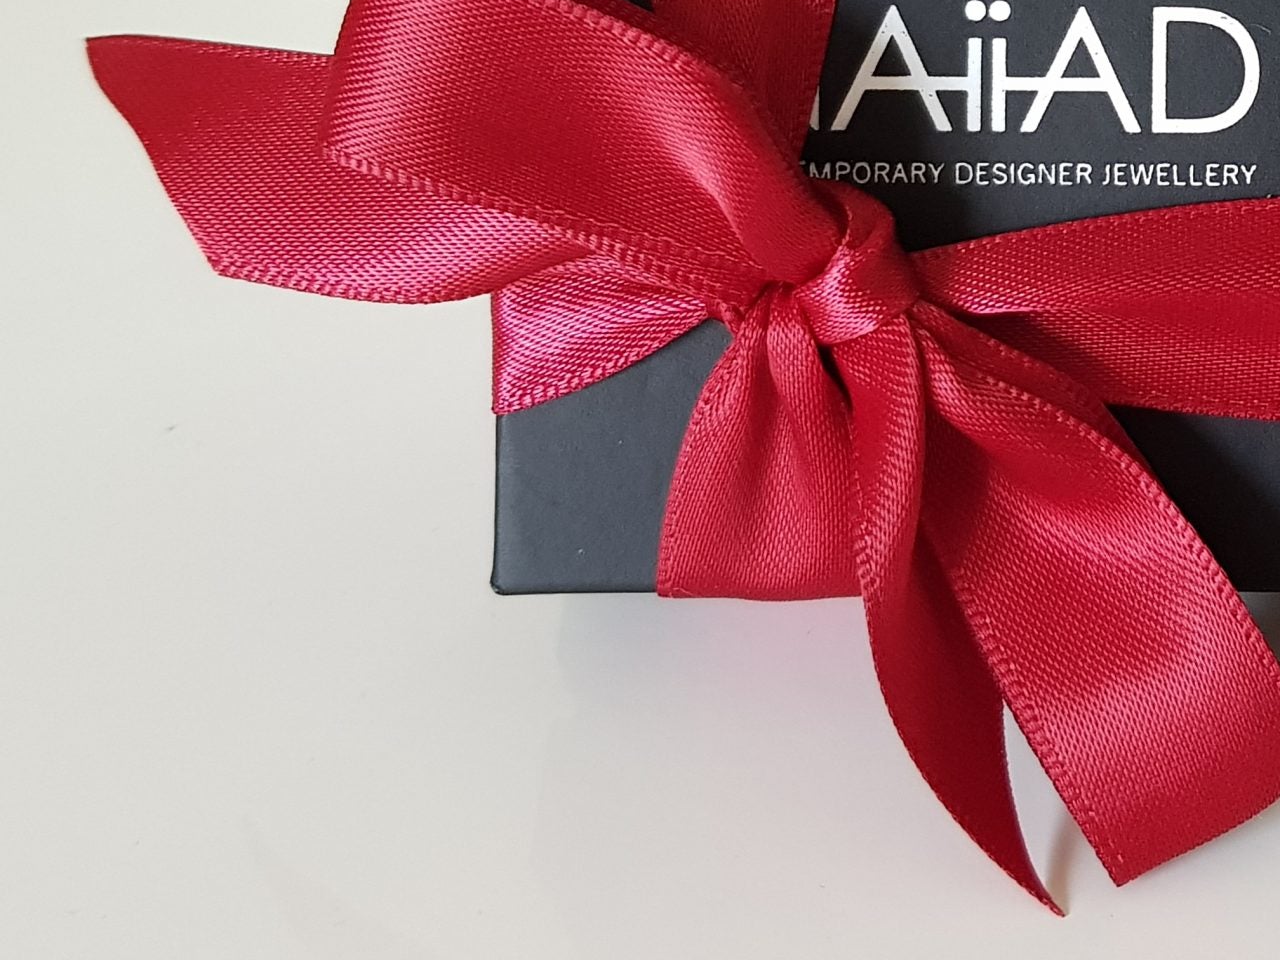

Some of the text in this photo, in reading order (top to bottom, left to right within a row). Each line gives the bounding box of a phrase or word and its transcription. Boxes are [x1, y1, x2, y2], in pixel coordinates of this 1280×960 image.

[799, 160, 1257, 187] MPORARY DESIGNER JEWELLERY
